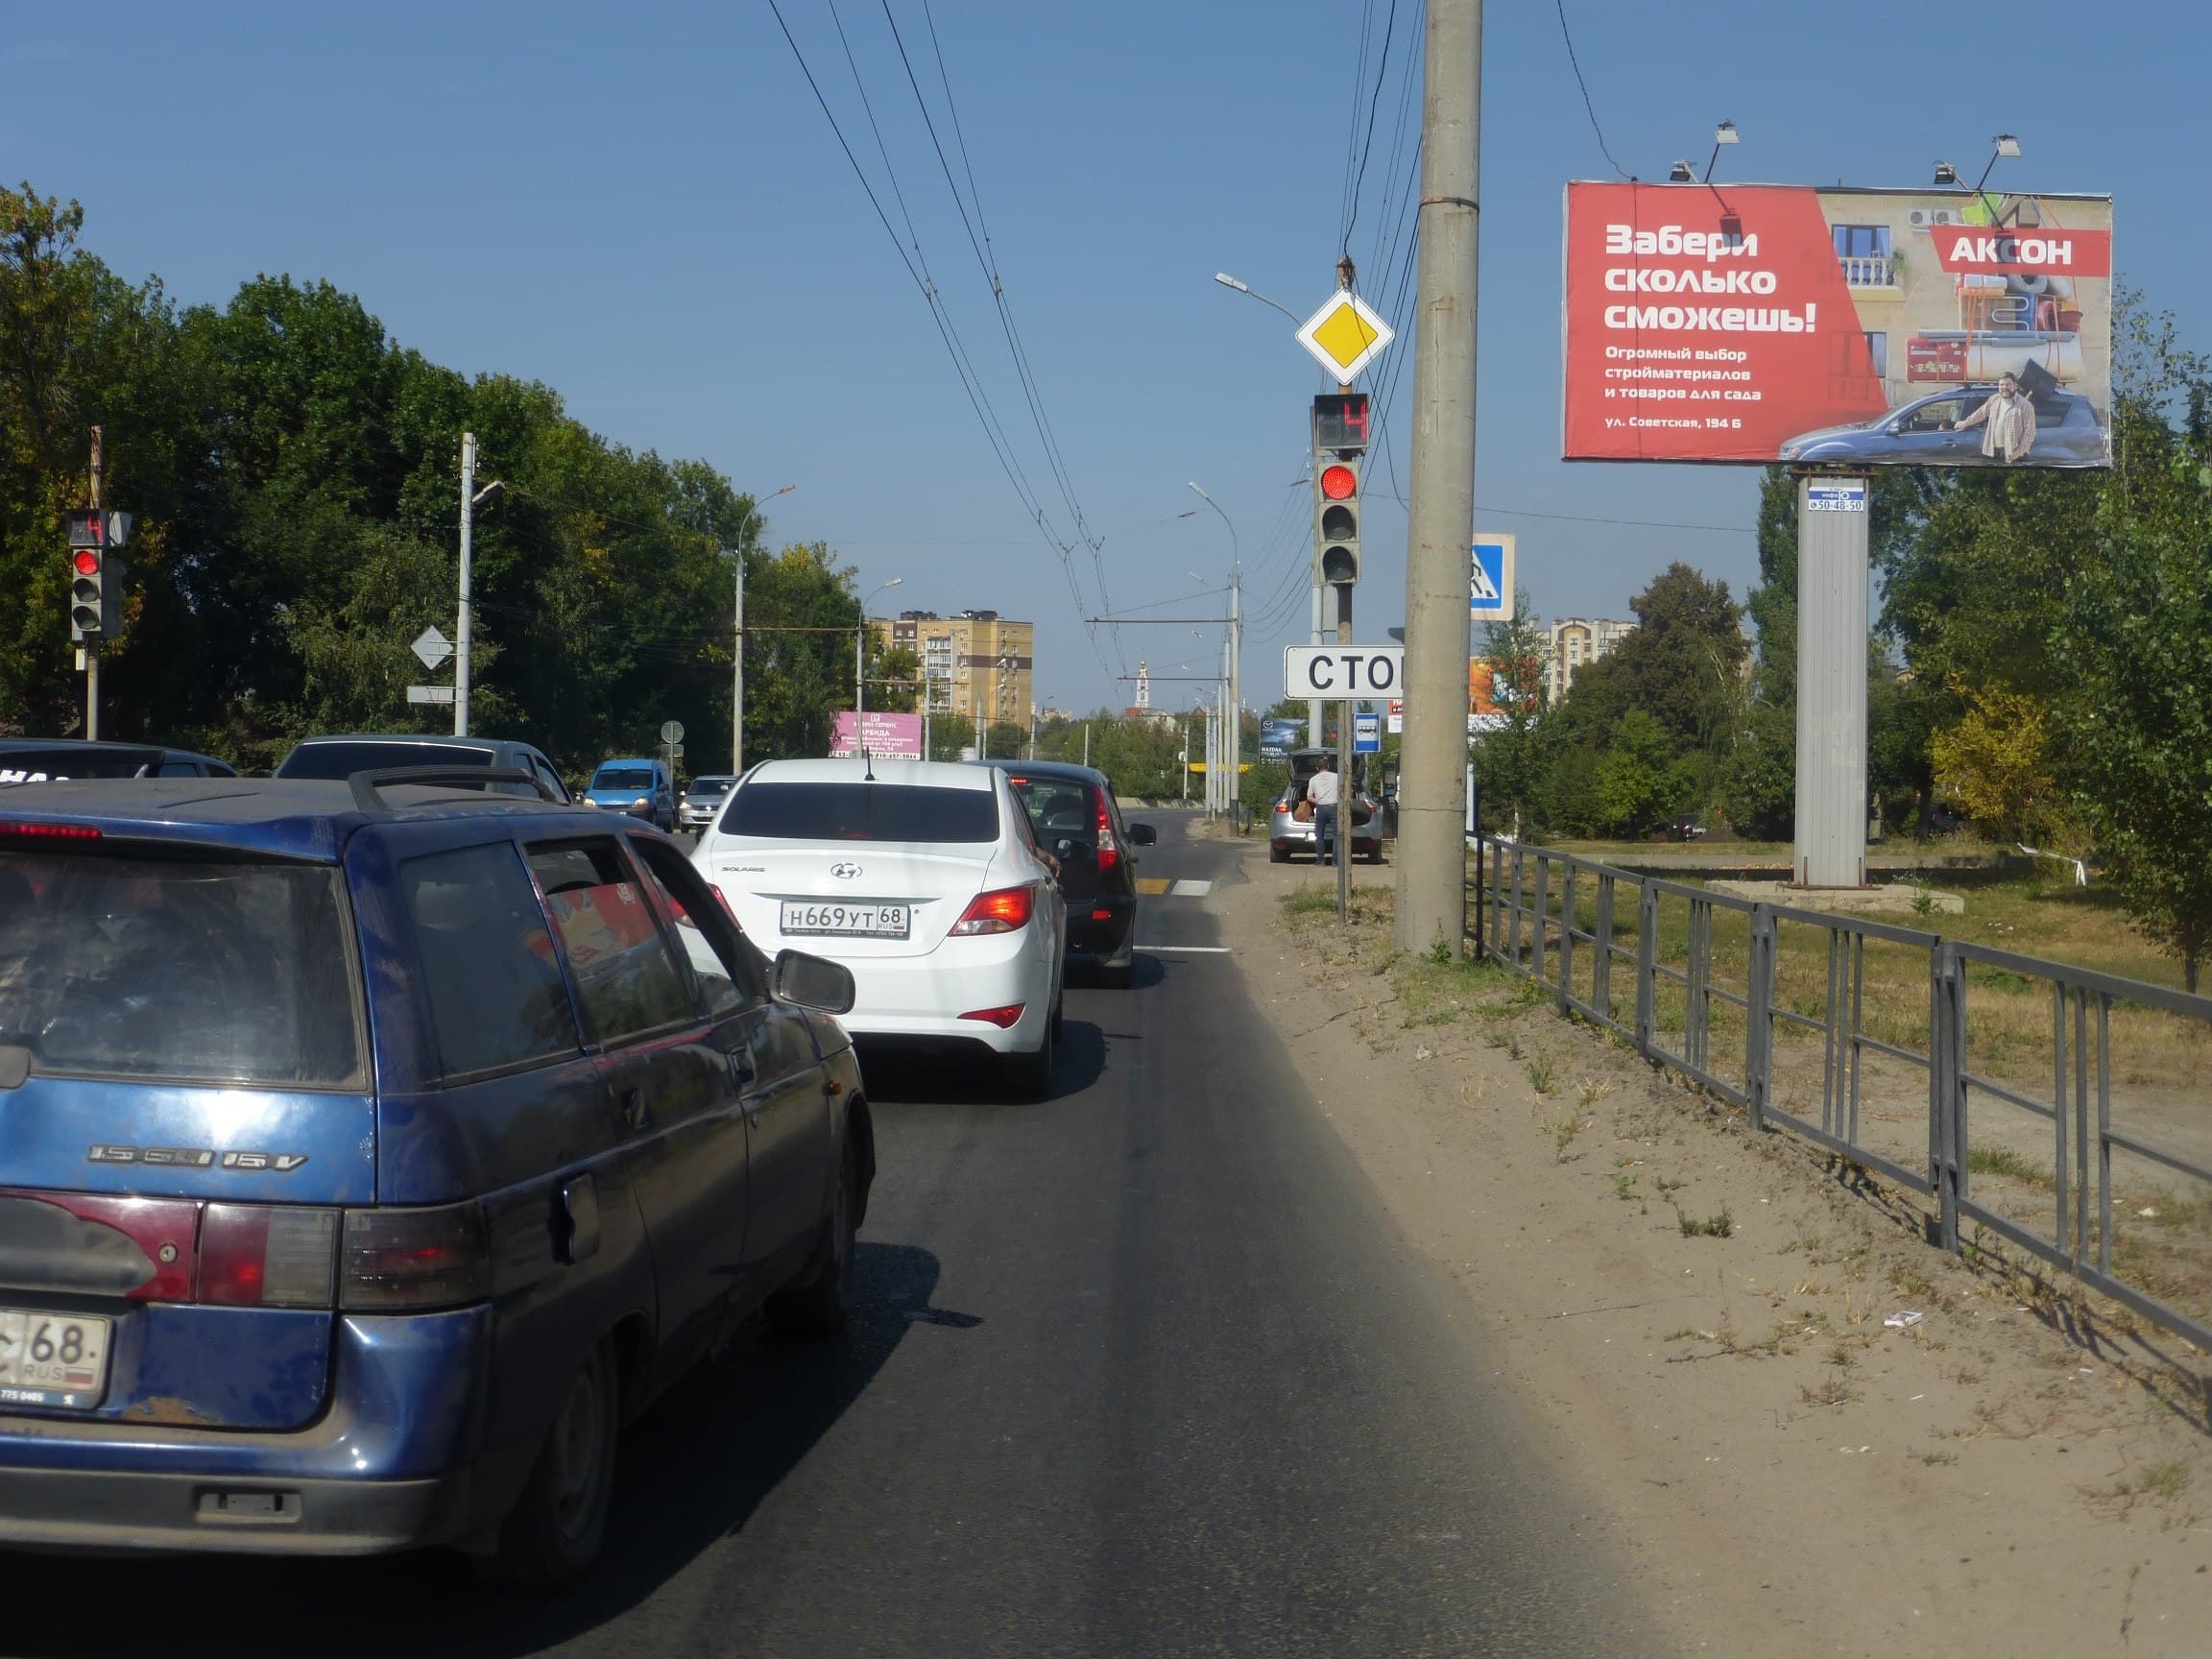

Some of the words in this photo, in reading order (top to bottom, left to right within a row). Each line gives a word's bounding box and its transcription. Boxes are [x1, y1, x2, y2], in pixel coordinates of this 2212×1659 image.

[1605, 225, 1758, 262] Забери
[1950, 237, 2072, 265] АКСОН
[1604, 269, 1776, 294] сколько
[1604, 302, 1816, 333] сможешь!
[1605, 346, 1692, 361] Огромный
[1695, 349, 1747, 363] выбор
[1605, 367, 1751, 381] стройматериалов
[1605, 388, 1615, 397] и
[1619, 388, 1686, 400] товаров
[1690, 389, 1720, 400] для
[1724, 390, 1762, 400] сада
[1605, 418, 1625, 428] ул.
[1629, 417, 1702, 429] Советская,
[1705, 418, 1729, 428] 194
[1731, 419, 1742, 428] Б
[1818, 500, 1862, 510] 50-48-50
[1309, 655, 1404, 690] СТО
[879, 907, 901, 924] 68
[31, 1321, 84, 1364] 68
[23, 1364, 62, 1380] RUS
